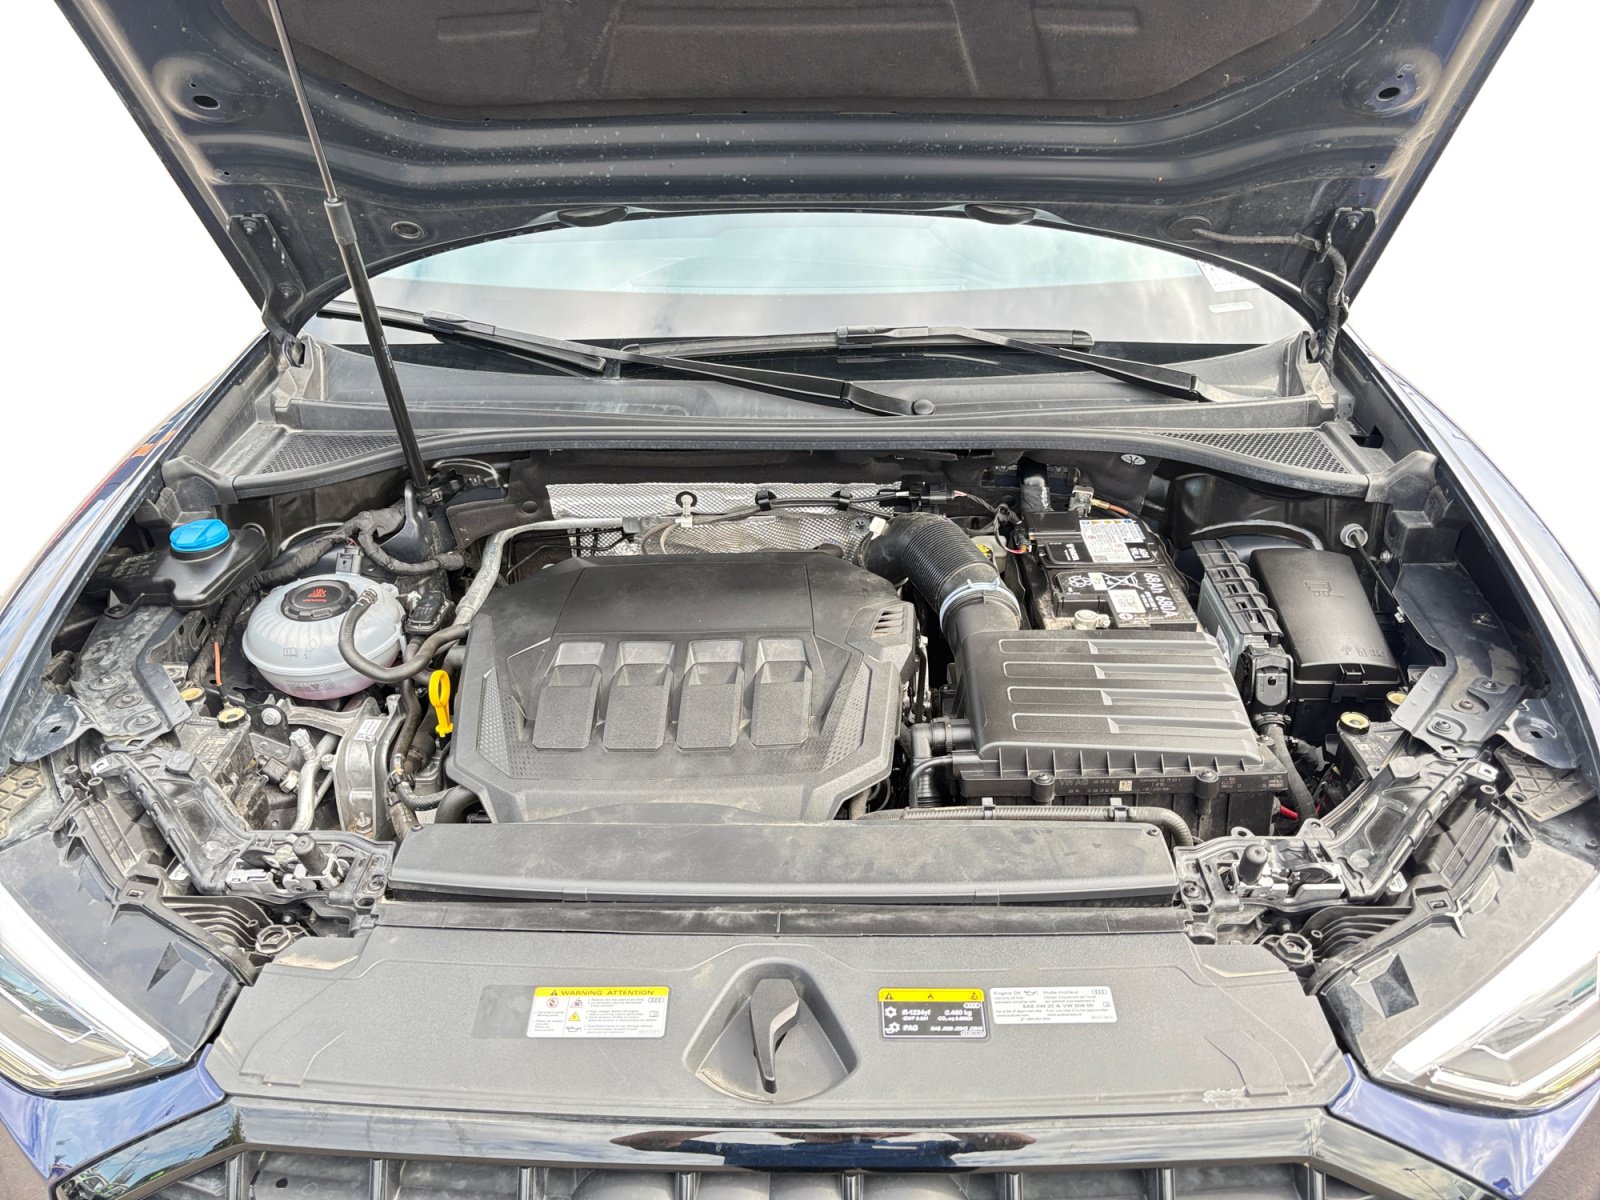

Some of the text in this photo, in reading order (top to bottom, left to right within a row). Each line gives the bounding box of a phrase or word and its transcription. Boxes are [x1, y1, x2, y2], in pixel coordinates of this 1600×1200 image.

[1143, 573, 1166, 594] 68Ah
[1155, 596, 1179, 617] 680A
[963, 1009, 973, 1017] kg
